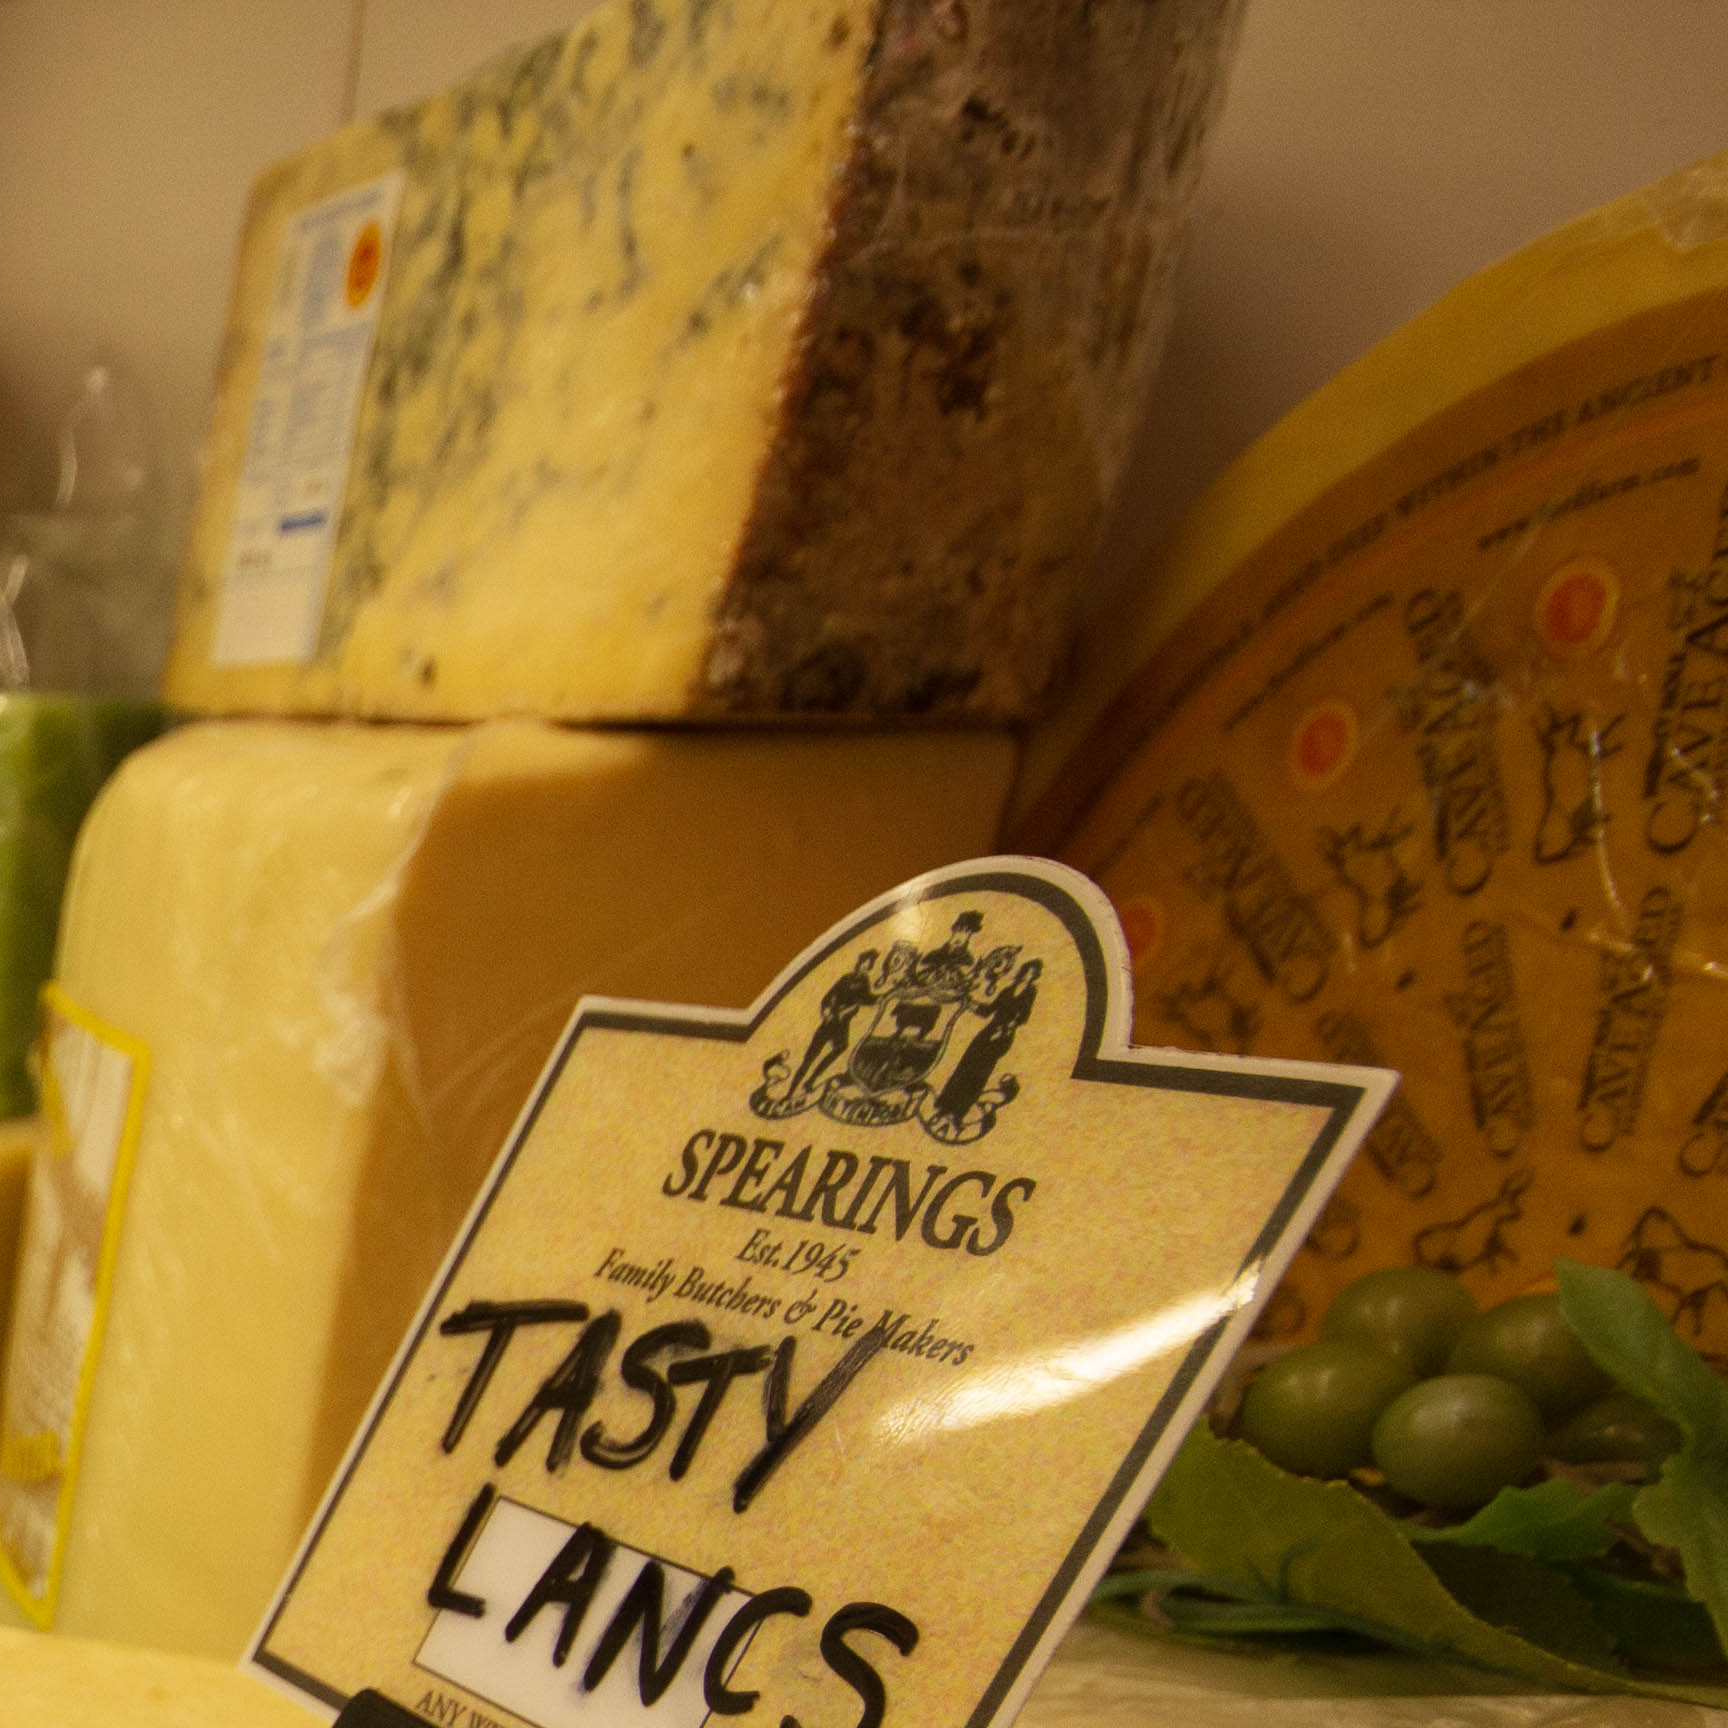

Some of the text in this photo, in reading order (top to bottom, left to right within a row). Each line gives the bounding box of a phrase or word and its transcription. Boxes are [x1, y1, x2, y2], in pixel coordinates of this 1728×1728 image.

[662, 1127, 1037, 1258] SPEARINGS
[594, 1247, 975, 1367] Family Butchers & Pie Makers
[439, 1297, 887, 1515] TASTY
[415, 1689, 468, 1728] ANY
